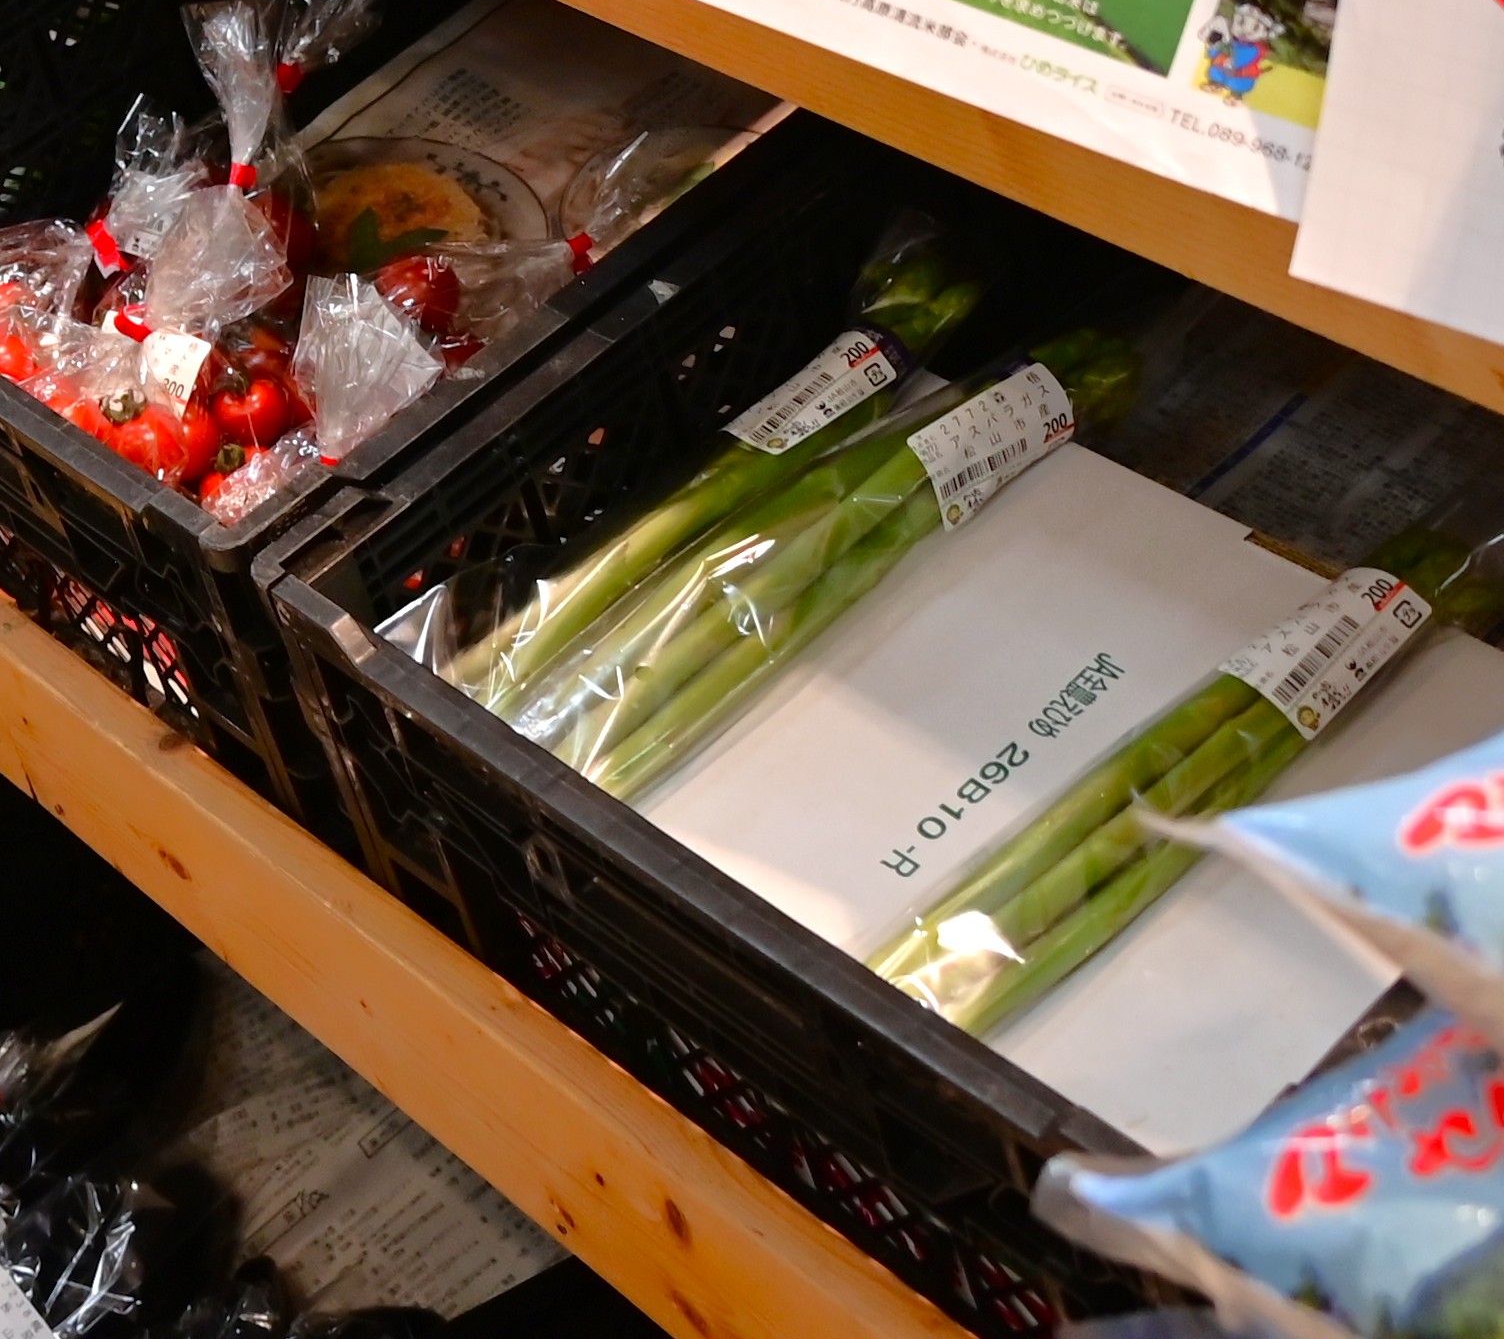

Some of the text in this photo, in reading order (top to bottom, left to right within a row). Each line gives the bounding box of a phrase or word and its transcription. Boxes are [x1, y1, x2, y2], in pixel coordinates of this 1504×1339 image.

[841, 340, 870, 367] 200
[949, 384, 1050, 450] アスパラガス
[1042, 412, 1069, 443] 200
[1360, 578, 1395, 612] 200
[1028, 650, 1122, 741] JA全農えひめ
